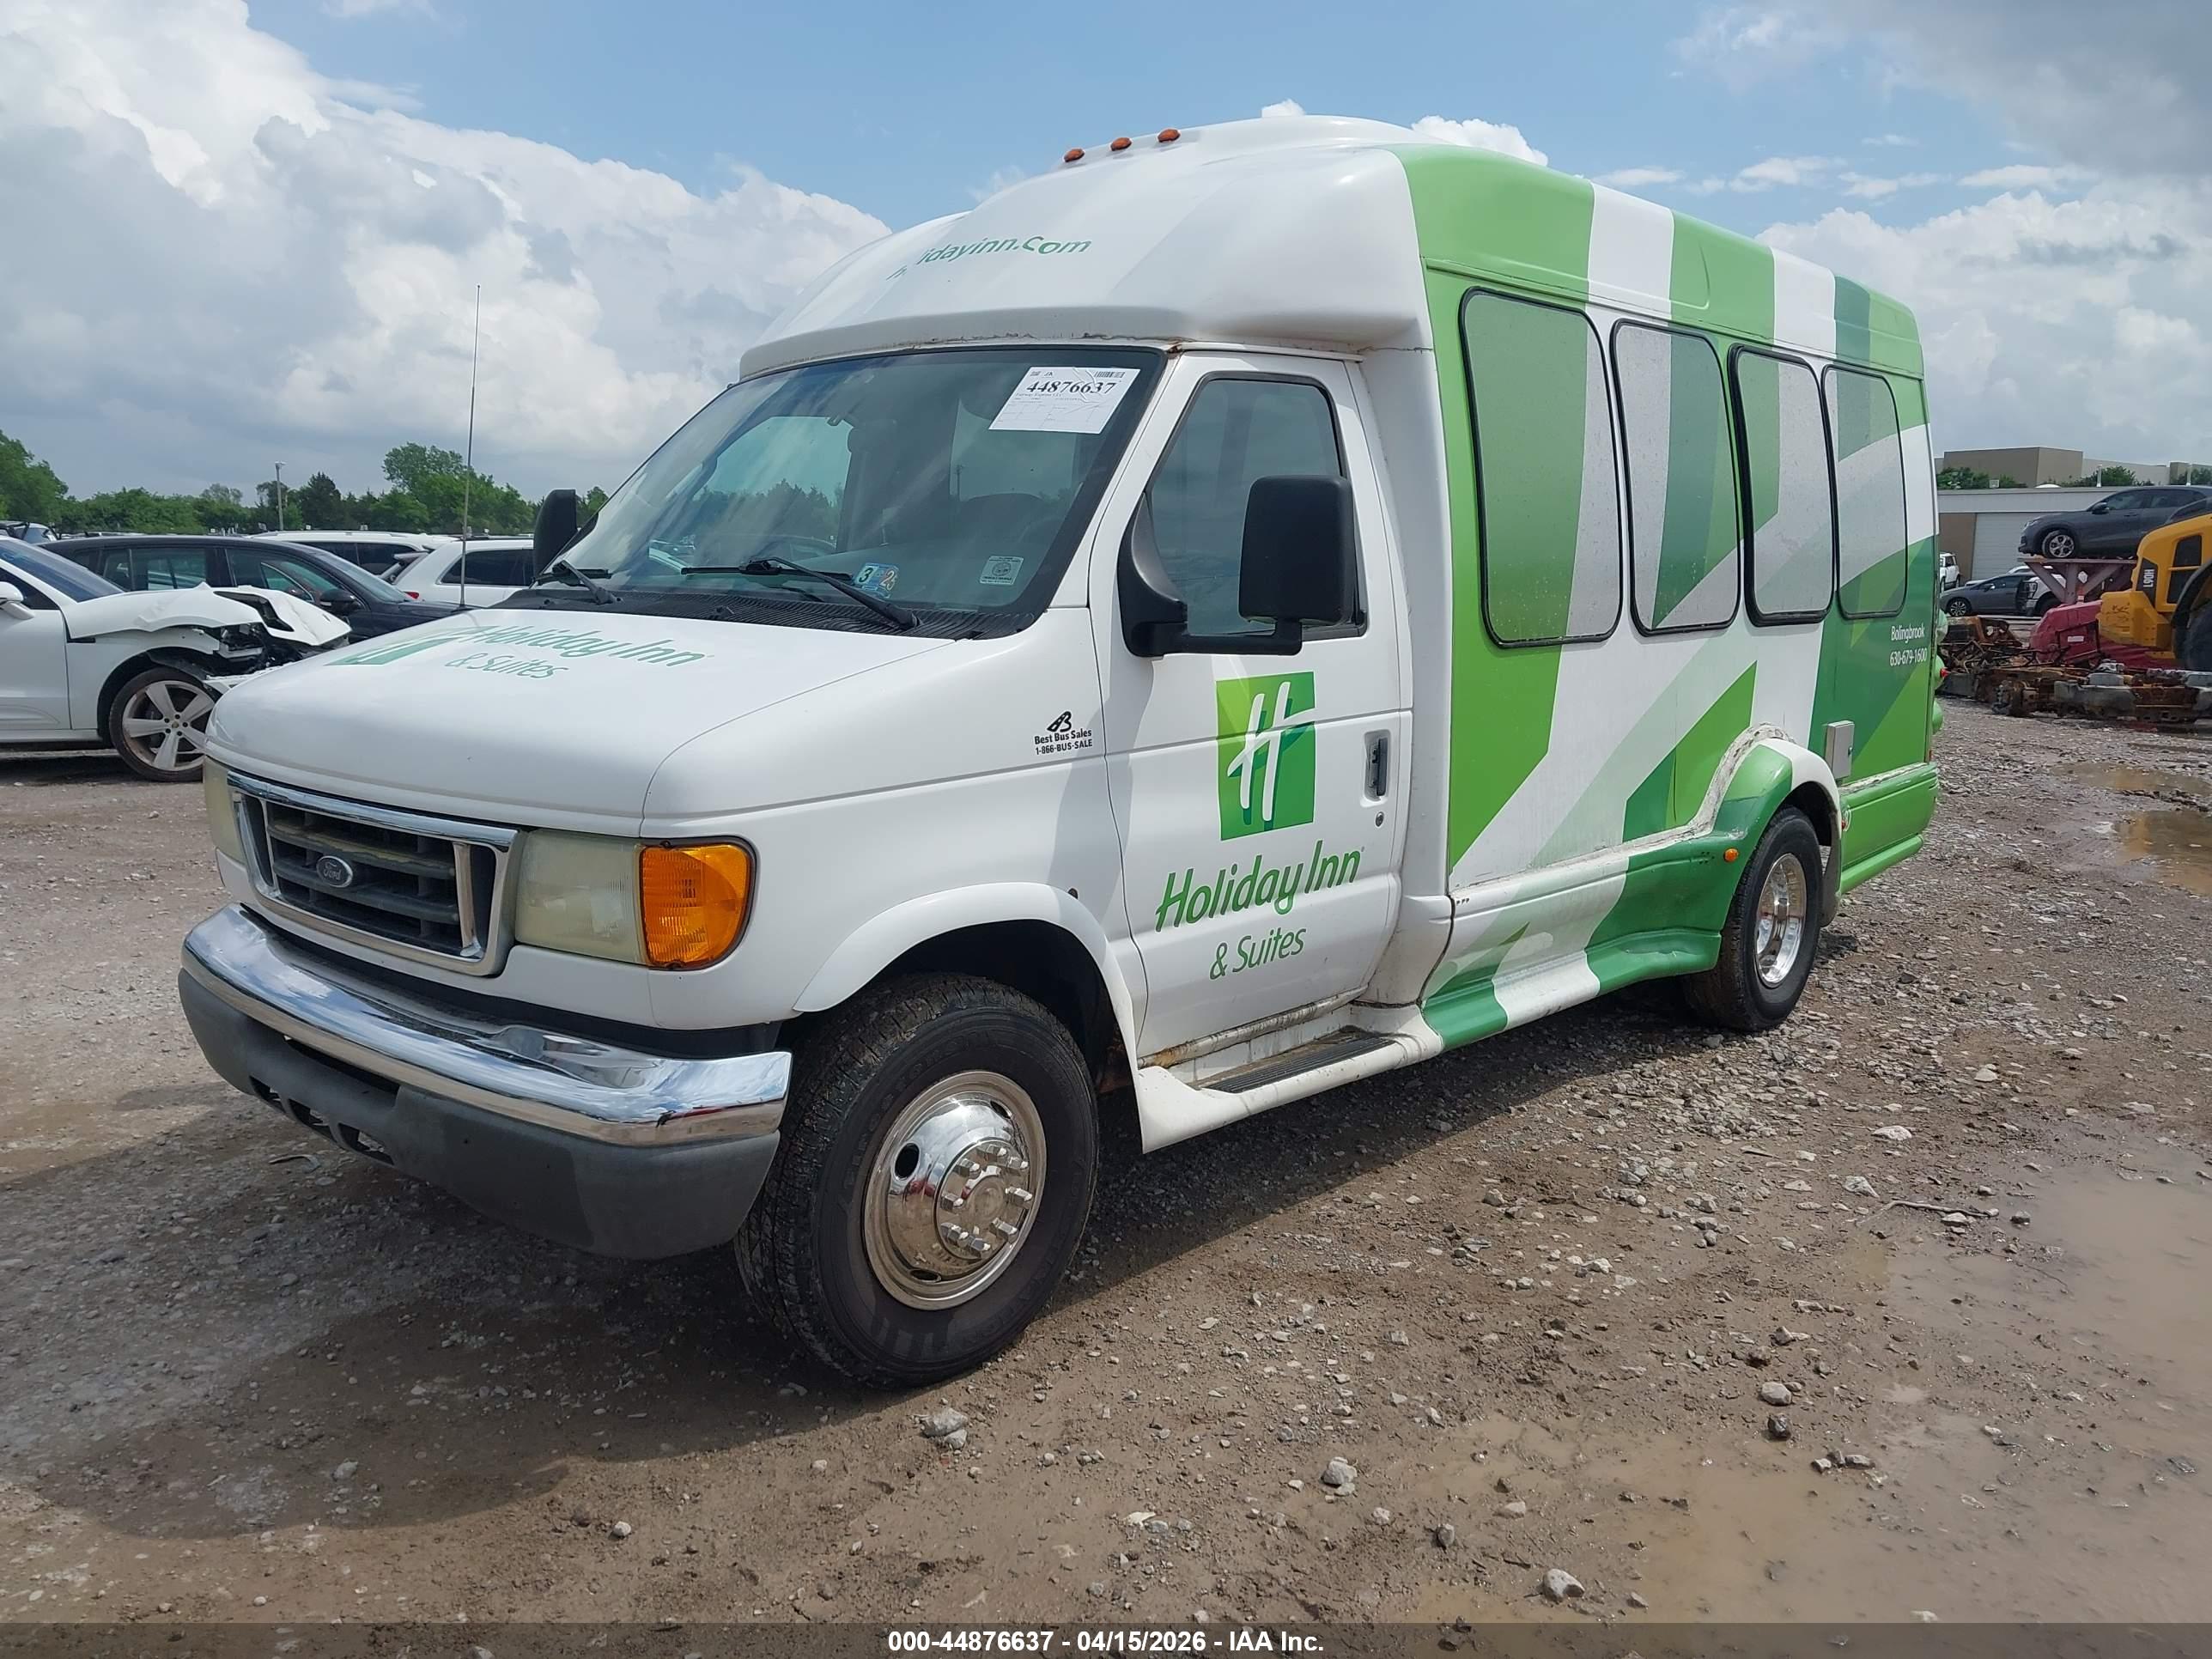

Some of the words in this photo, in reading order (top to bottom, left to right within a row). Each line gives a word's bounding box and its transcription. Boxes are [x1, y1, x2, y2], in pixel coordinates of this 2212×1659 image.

[886, 236, 1092, 281] idayinn.Com
[1026, 380, 1116, 394] 44876637
[859, 568, 873, 583] 3
[1891, 623, 1925, 643] Bolingbrook
[459, 626, 633, 658] Holiday
[608, 639, 705, 667] Inn
[445, 653, 488, 666] &
[467, 655, 569, 678] Suites
[1890, 647, 1928, 666] 630-679-1600
[1035, 734, 1053, 744] Best
[1054, 732, 1069, 742] Bus
[1071, 728, 1092, 739] Sales
[1036, 738, 1092, 755] 1-866-BUS-SALE
[324, 861, 341, 880] Ford
[1155, 854, 1304, 933] Holiday
[1304, 840, 1362, 894] Inn
[1210, 942, 1228, 980] &
[1233, 927, 1307, 973] Suites
